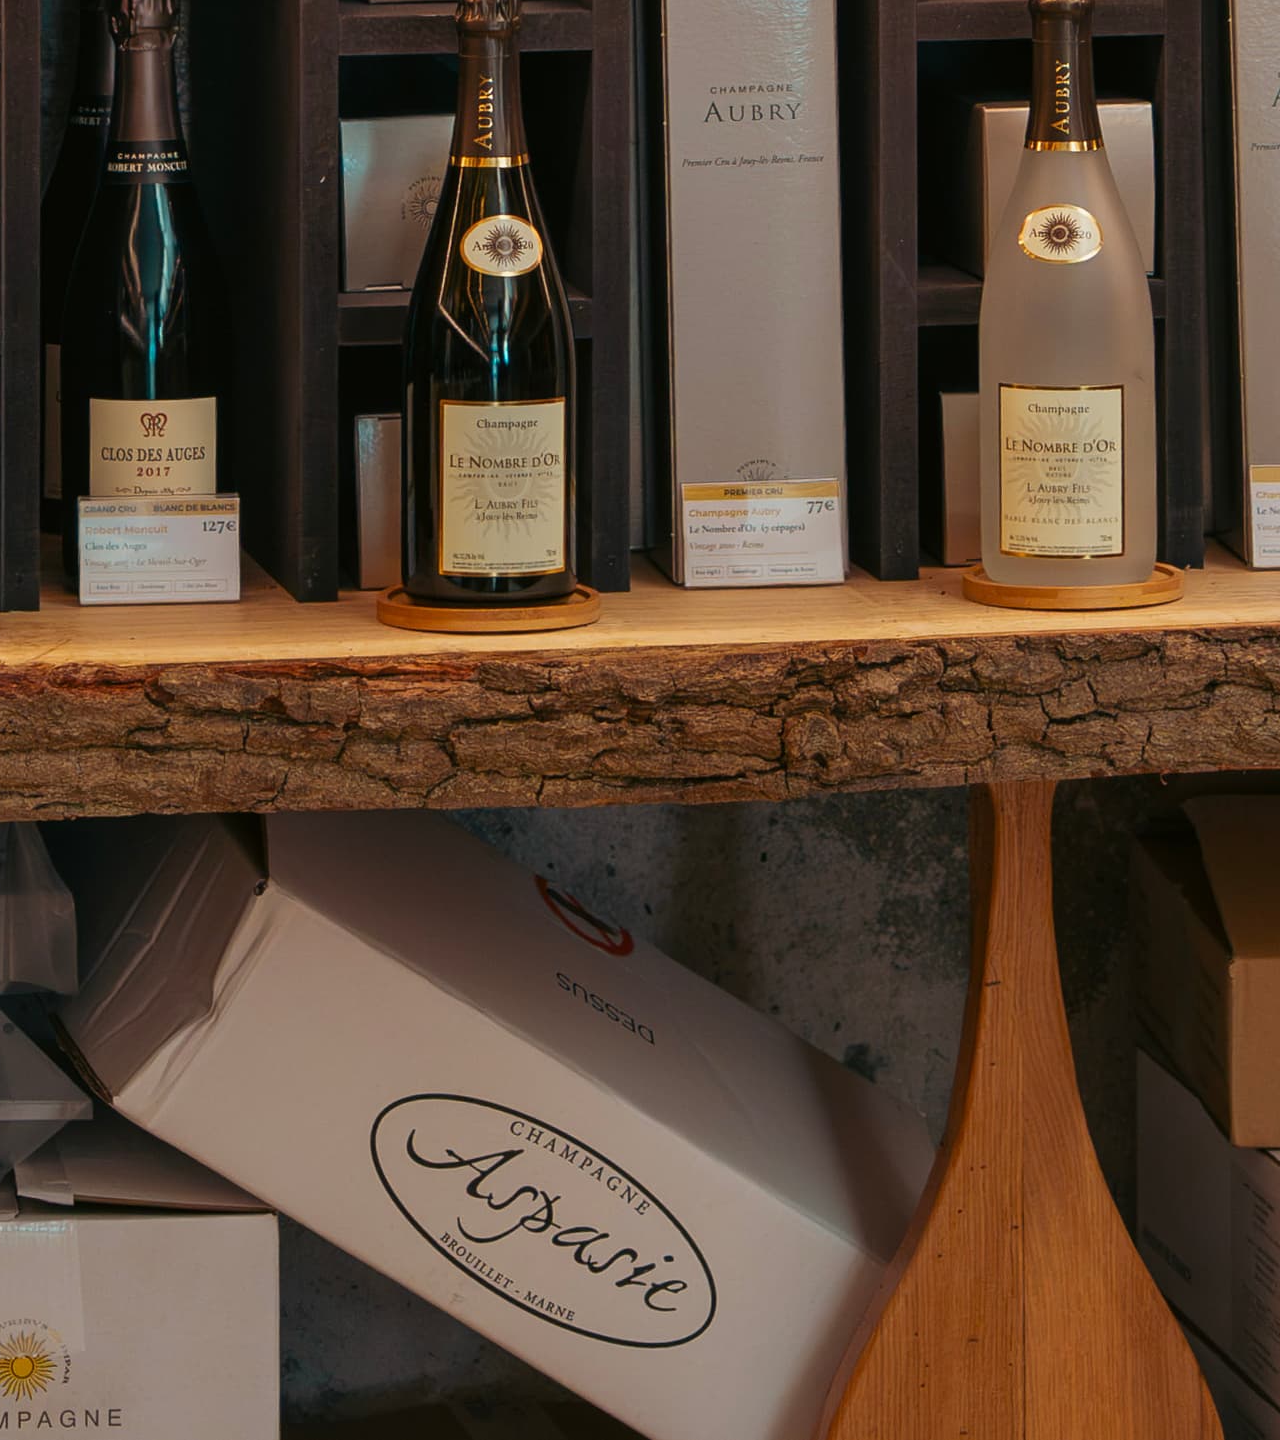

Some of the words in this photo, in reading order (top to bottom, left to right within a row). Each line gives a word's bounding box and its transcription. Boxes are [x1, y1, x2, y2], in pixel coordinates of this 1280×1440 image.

[710, 84, 793, 94] CHAMPAGNE
[1050, 61, 1069, 135] AUBRY
[473, 75, 494, 150] AUBRY
[704, 101, 801, 123] AUBRY
[117, 151, 178, 159] CHAMPAGNE
[1028, 404, 1090, 415] Champagne
[477, 419, 538, 430] Champagne
[101, 447, 133, 461] CLOS
[138, 449, 162, 461] DES
[168, 447, 205, 461] AUGES
[136, 467, 170, 476] 2017
[689, 510, 748, 518] Champagne
[807, 501, 834, 514] 77€
[202, 521, 236, 534] 127€
[556, 972, 655, 1045] DESSUS
[510, 1120, 650, 1215] CHAMPAGNE
[406, 1129, 687, 1311] Aspasie
[439, 1232, 513, 1289] BROUILLET
[523, 1291, 575, 1321] MARNE
